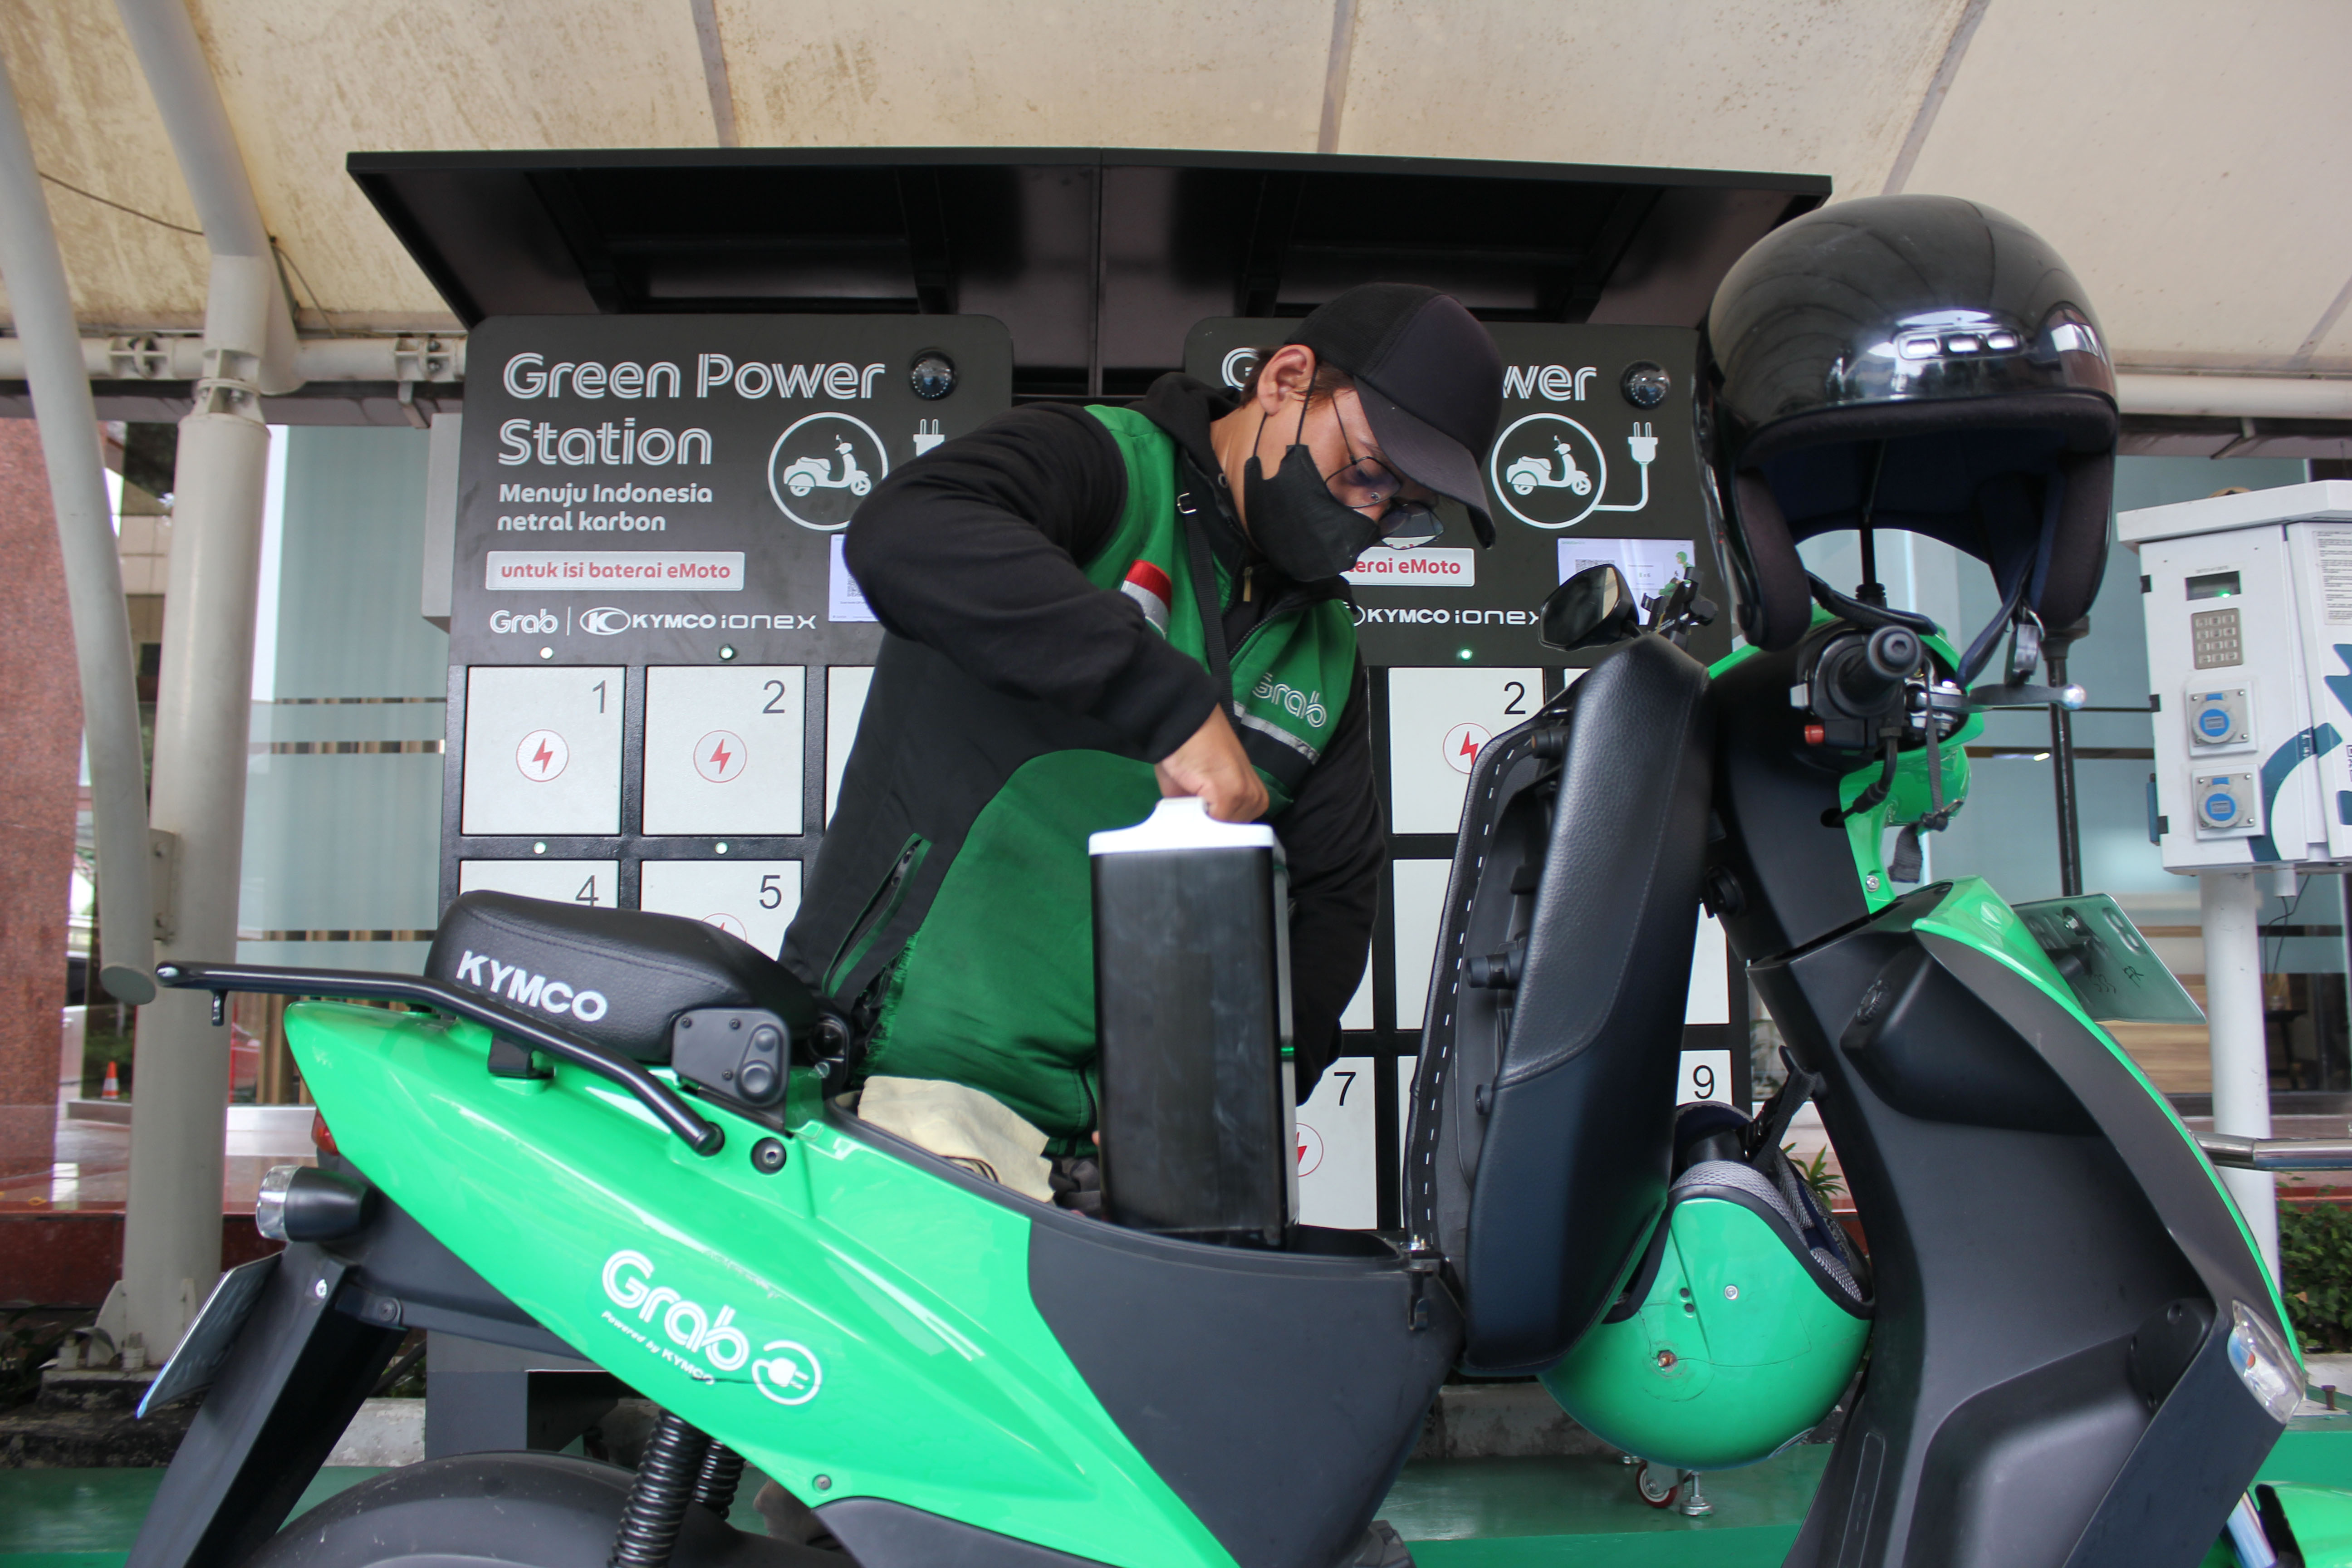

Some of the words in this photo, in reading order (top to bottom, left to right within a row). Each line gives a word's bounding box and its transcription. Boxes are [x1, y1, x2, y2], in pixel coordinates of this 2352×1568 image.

[503, 353, 681, 399] Green
[696, 353, 885, 399] Power
[1503, 365, 1597, 401] wer
[498, 417, 712, 466] Station
[499, 482, 587, 507] Menuju
[593, 482, 712, 503] Indonesia
[497, 510, 573, 531] netral
[578, 510, 666, 531] karbon
[501, 562, 558, 578] untuk
[564, 562, 584, 578] isi
[589, 562, 662, 578] baterai
[667, 563, 730, 578] eMoto
[1349, 558, 1393, 573] erai
[1399, 559, 1461, 574] eMoto
[490, 608, 559, 634] Grab
[632, 613, 717, 629] KYMCO
[720, 614, 817, 629] ionex
[1367, 608, 1450, 624] KYMCO
[592, 680, 606, 714] 1
[762, 680, 785, 714] 2
[1504, 681, 1526, 715] 2
[575, 875, 599, 907] 4
[759, 875, 782, 909] 5
[456, 950, 608, 1022] KYMCO
[1333, 1072, 1356, 1106] 7
[1693, 1065, 1714, 1099] 9
[602, 1250, 750, 1371] Grab
[601, 1310, 647, 1343] Powered
[645, 1340, 661, 1353] by
